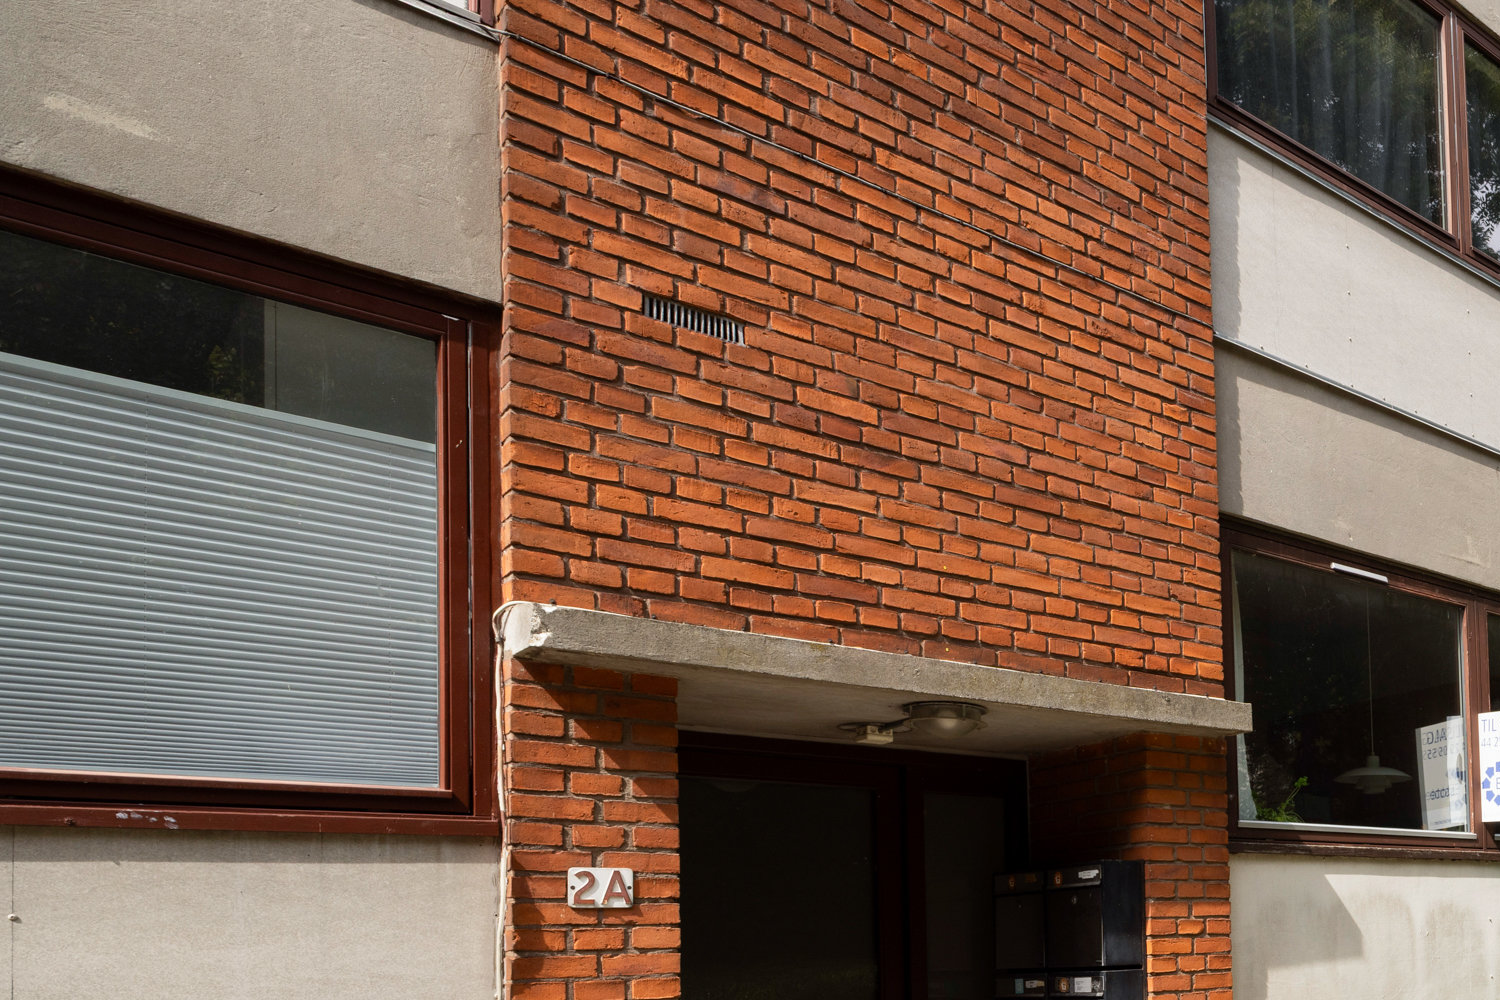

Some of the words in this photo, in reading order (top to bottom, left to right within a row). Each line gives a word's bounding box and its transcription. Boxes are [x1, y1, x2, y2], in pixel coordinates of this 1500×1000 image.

[1481, 719, 1497, 733] TIL
[1481, 737, 1492, 747] 44
[573, 870, 633, 905] 2A
